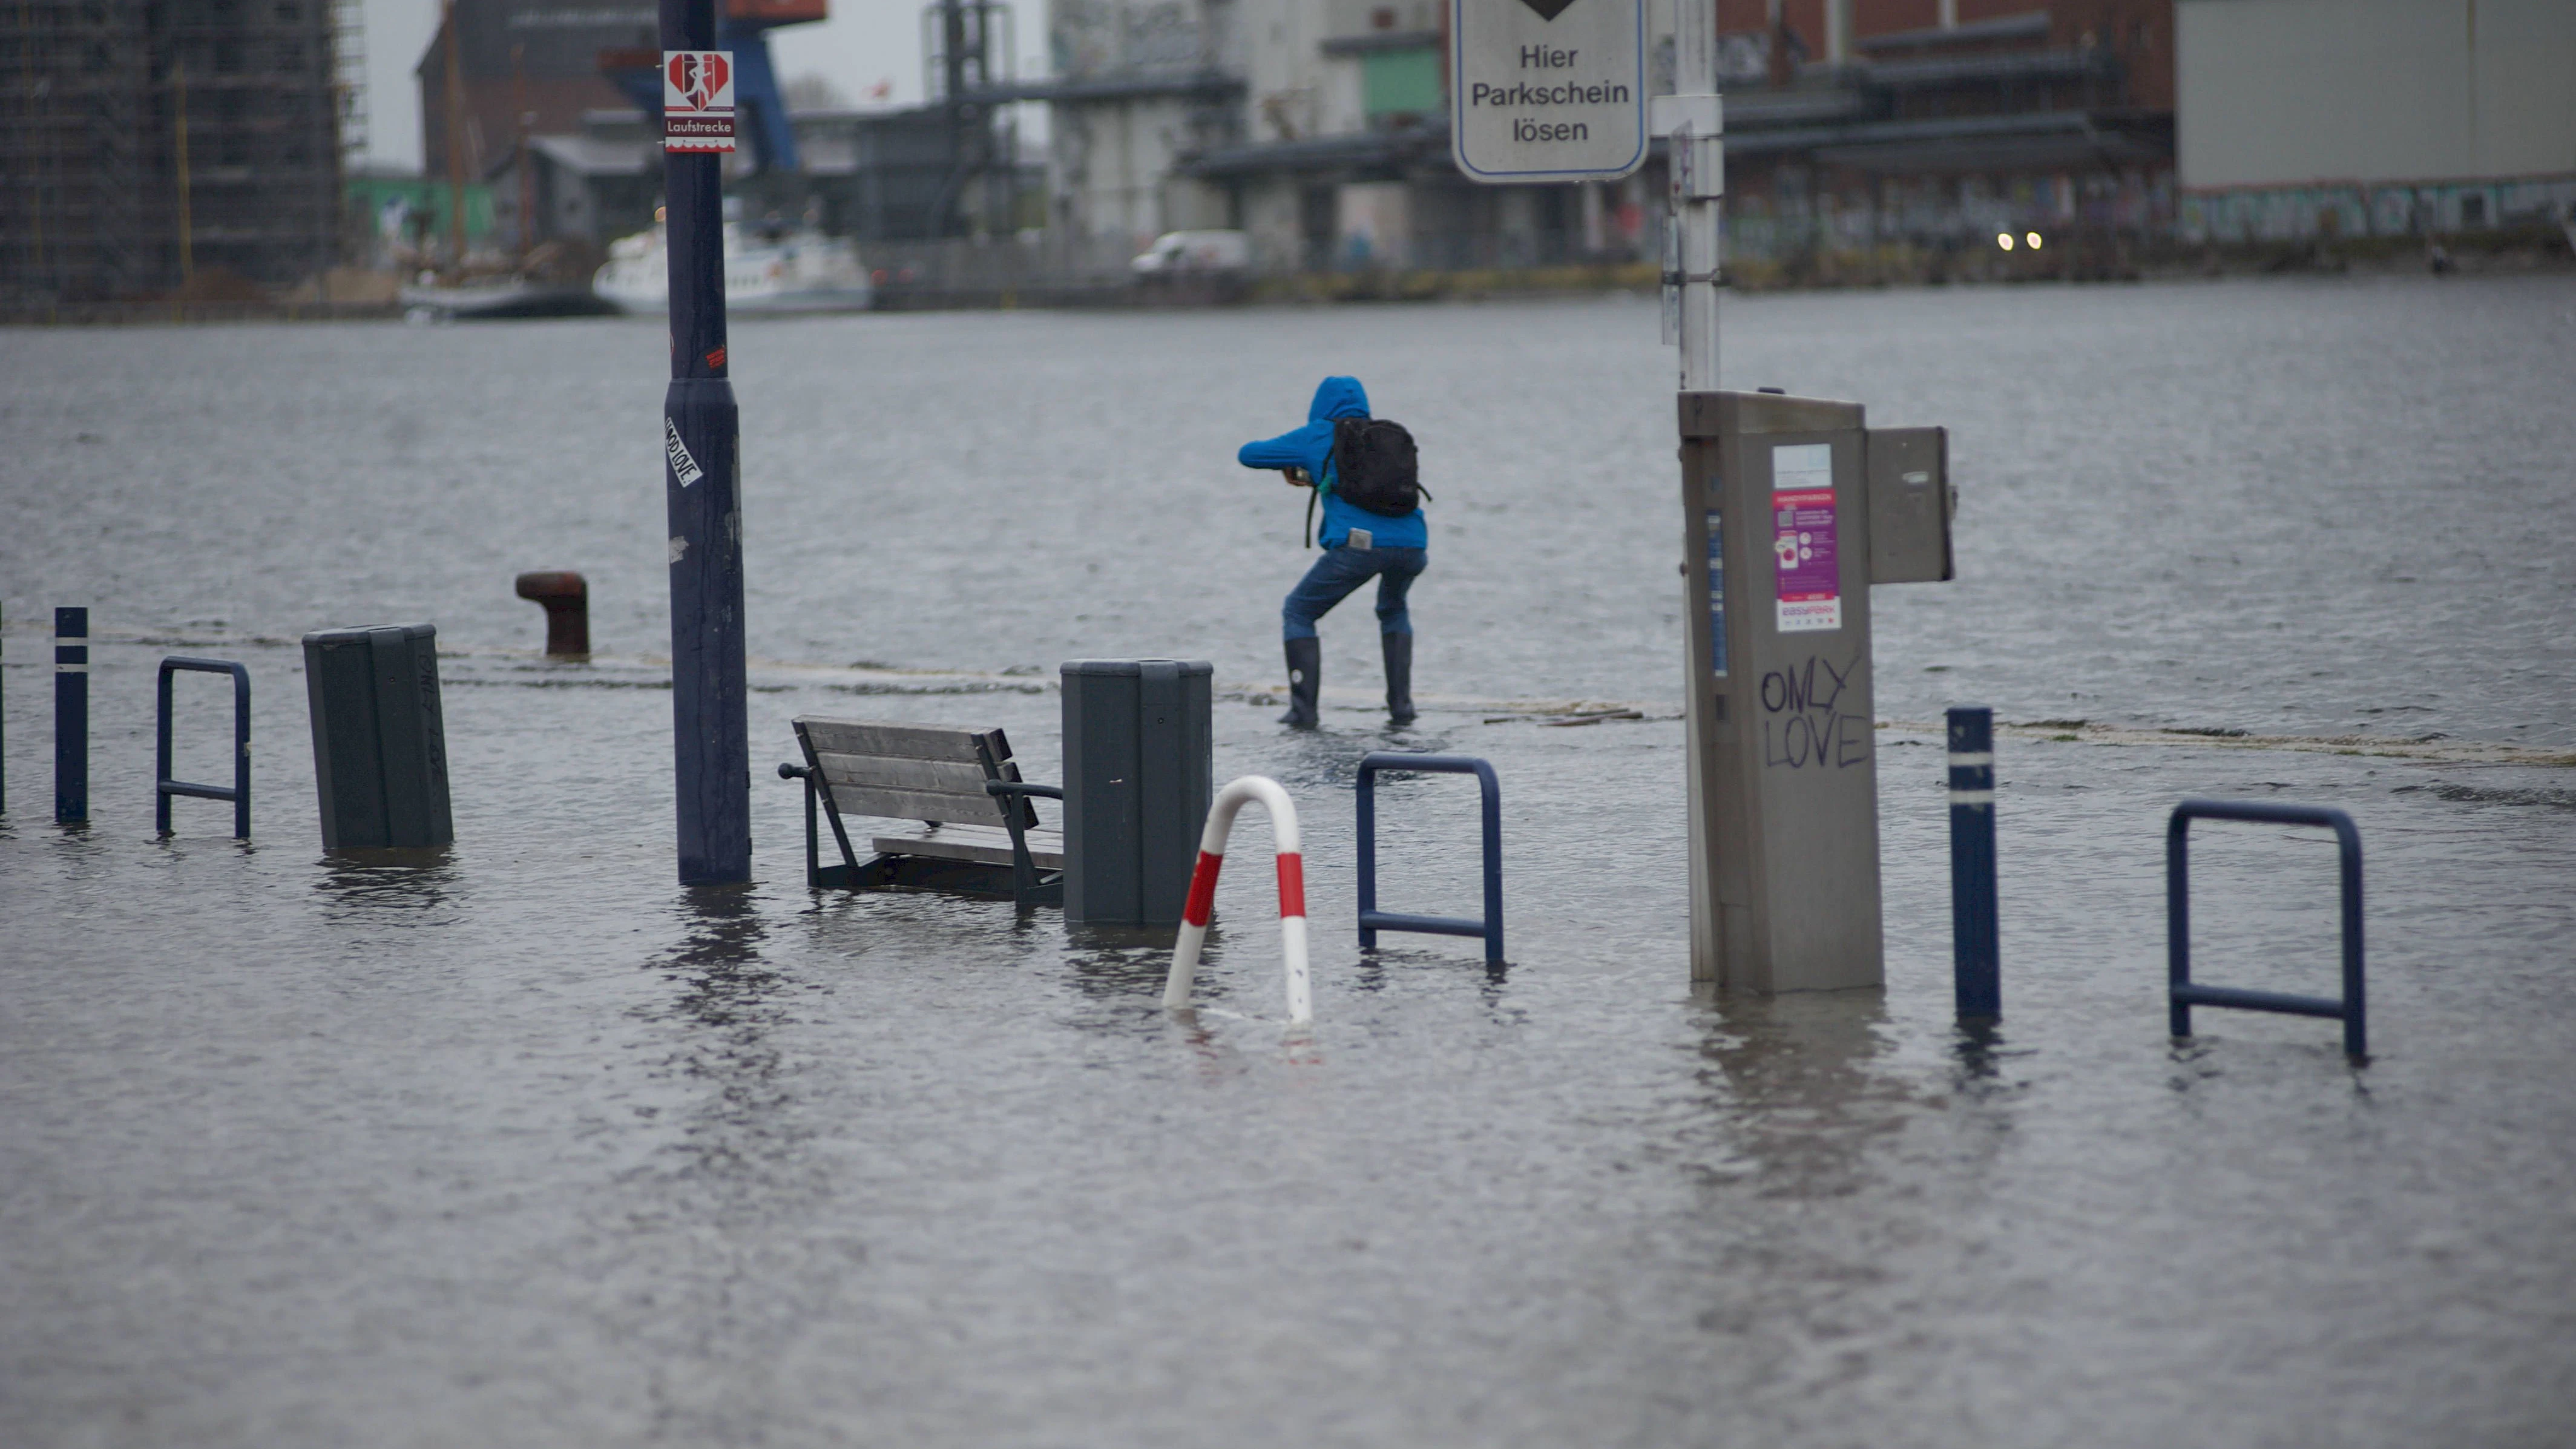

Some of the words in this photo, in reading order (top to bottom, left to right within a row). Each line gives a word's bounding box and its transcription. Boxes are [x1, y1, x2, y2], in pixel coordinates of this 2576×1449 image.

[1521, 44, 1579, 68] Hier
[1472, 79, 1629, 107] Parkschein
[668, 120, 731, 133] Laufstrecke
[1513, 118, 1588, 142] lösen
[1761, 655, 1862, 714] ONLY
[1764, 711, 1871, 769] LOVE
